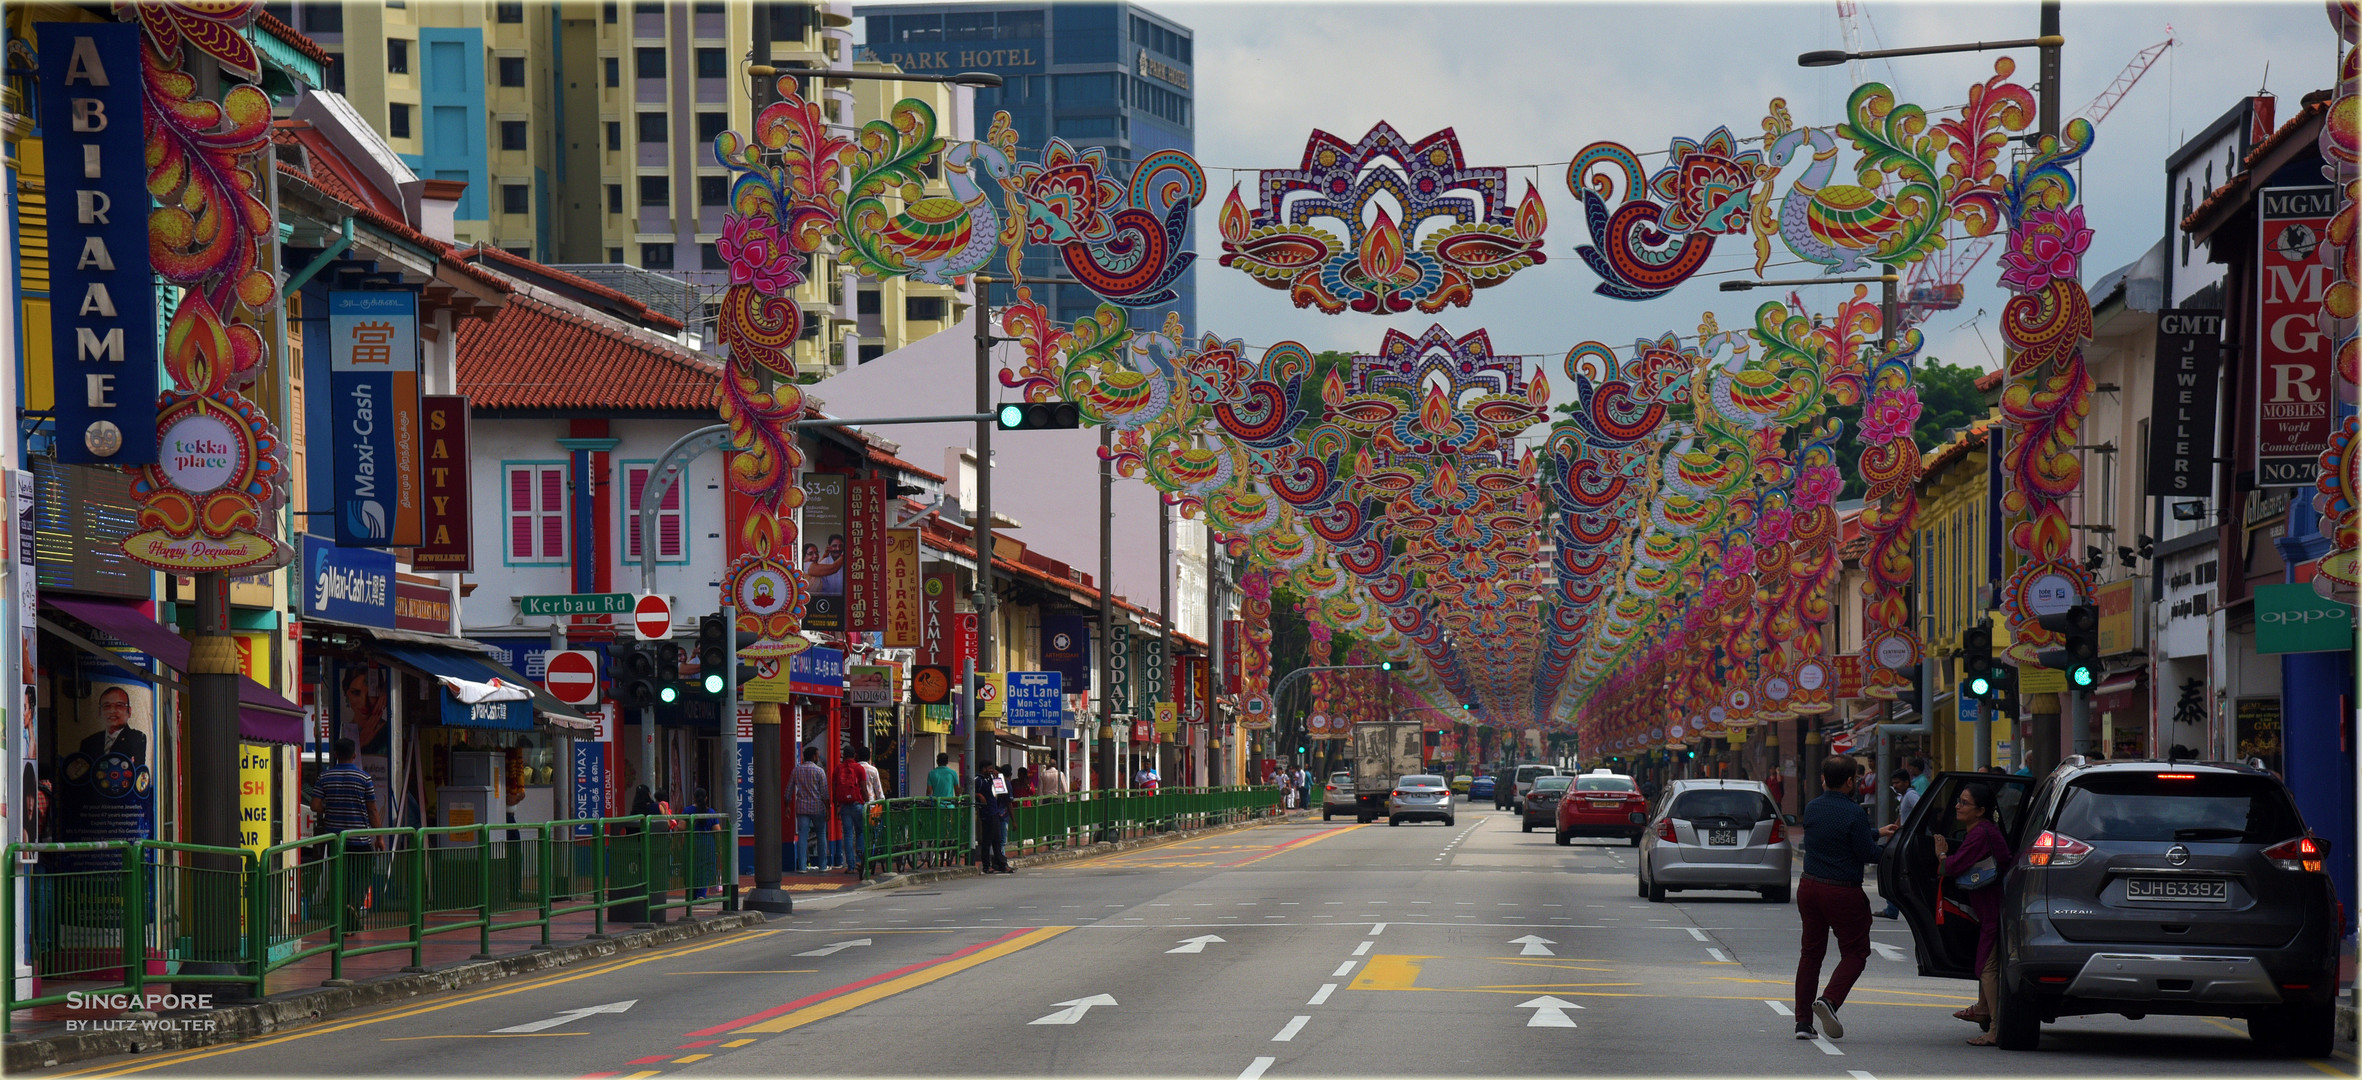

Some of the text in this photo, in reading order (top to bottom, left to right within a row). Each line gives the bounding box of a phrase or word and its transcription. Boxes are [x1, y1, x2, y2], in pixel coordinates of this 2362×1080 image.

[890, 48, 1037, 70] PARK HOTEL
[1148, 59, 1189, 90] PARK HOTEL
[2265, 194, 2332, 215] MGM
[65, 36, 127, 408] ABIRAAME
[2160, 314, 2220, 336] GMT
[2265, 265, 2324, 403] MGR
[352, 320, 395, 365] 當
[2173, 339, 2196, 490] JEWELLERS
[2262, 403, 2326, 418] MOBILES
[2278, 422, 2311, 433] World
[90, 429, 120, 449] 69
[174, 436, 228, 455] tekka
[351, 384, 376, 498] Maxi-Cash
[2260, 441, 2327, 453] Connections
[2288, 432, 2299, 443] of
[174, 456, 228, 471] place
[430, 410, 452, 545] SATYA
[148, 541, 249, 560] Happy Deepavali
[417, 554, 466, 562] JEWELLERY
[868, 486, 881, 626] KAMALA JEWELLERS
[329, 565, 365, 604] Maxi-Cash
[530, 596, 626, 613] Kerbau Rd
[894, 557, 909, 642] ABIRAAME
[910, 570, 920, 642] JEWELLERS
[2261, 608, 2346, 625] oppo
[1110, 626, 1127, 713] GOODAY
[1009, 684, 1060, 698] Bus Lane
[1017, 698, 1052, 708] Mon-Sat
[1962, 708, 1977, 718] ONE
[252, 754, 270, 770] For
[2129, 881, 2225, 897] SJH6339Z
[2053, 908, 2097, 916] X-TRAIL
